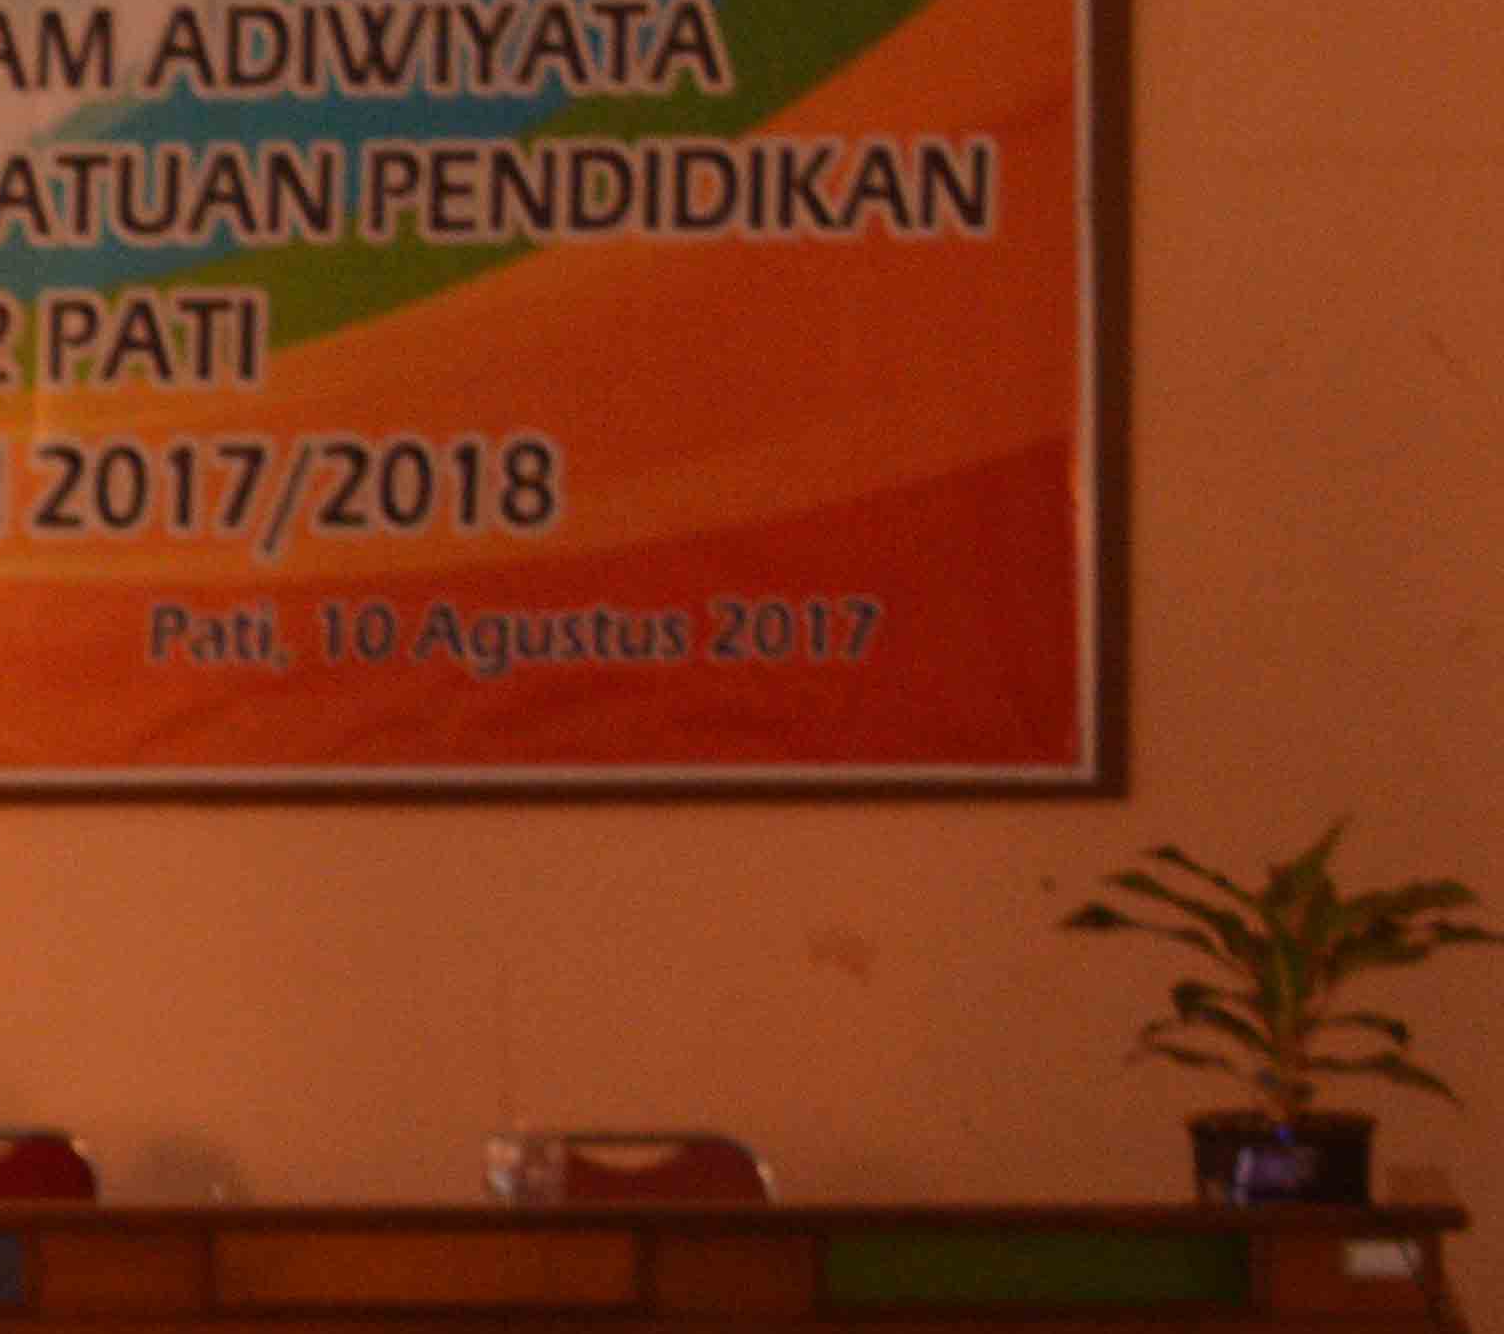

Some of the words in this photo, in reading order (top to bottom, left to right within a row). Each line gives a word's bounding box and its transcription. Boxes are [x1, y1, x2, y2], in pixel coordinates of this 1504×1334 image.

[144, 0, 729, 90] ADIWIYATA
[368, 140, 993, 234] PENDIDIKAN
[48, 297, 262, 383] PATI
[31, 440, 558, 559] 2017/2018
[151, 602, 288, 665] Pati,
[317, 603, 395, 660] 10
[413, 601, 689, 675] Agustus
[711, 600, 882, 659] 2017
